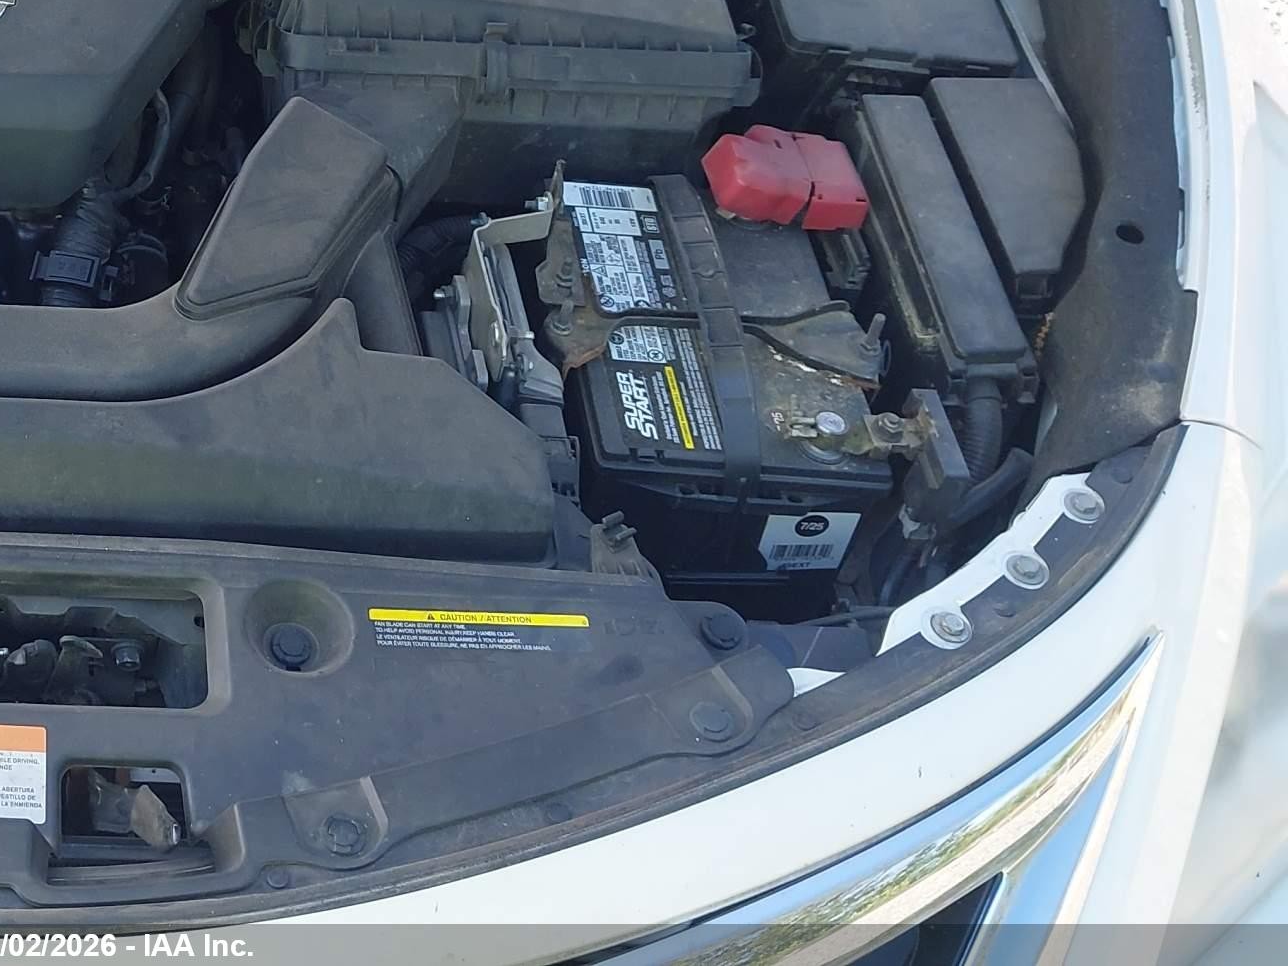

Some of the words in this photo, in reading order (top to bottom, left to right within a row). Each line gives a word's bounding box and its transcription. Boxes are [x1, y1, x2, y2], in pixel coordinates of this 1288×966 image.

[654, 249, 665, 260] Pb
[616, 371, 637, 429] SUPER
[628, 372, 659, 440] START
[800, 521, 825, 531] 7/25
[439, 613, 477, 621] CAUTION
[486, 615, 532, 623] ATTENTION
